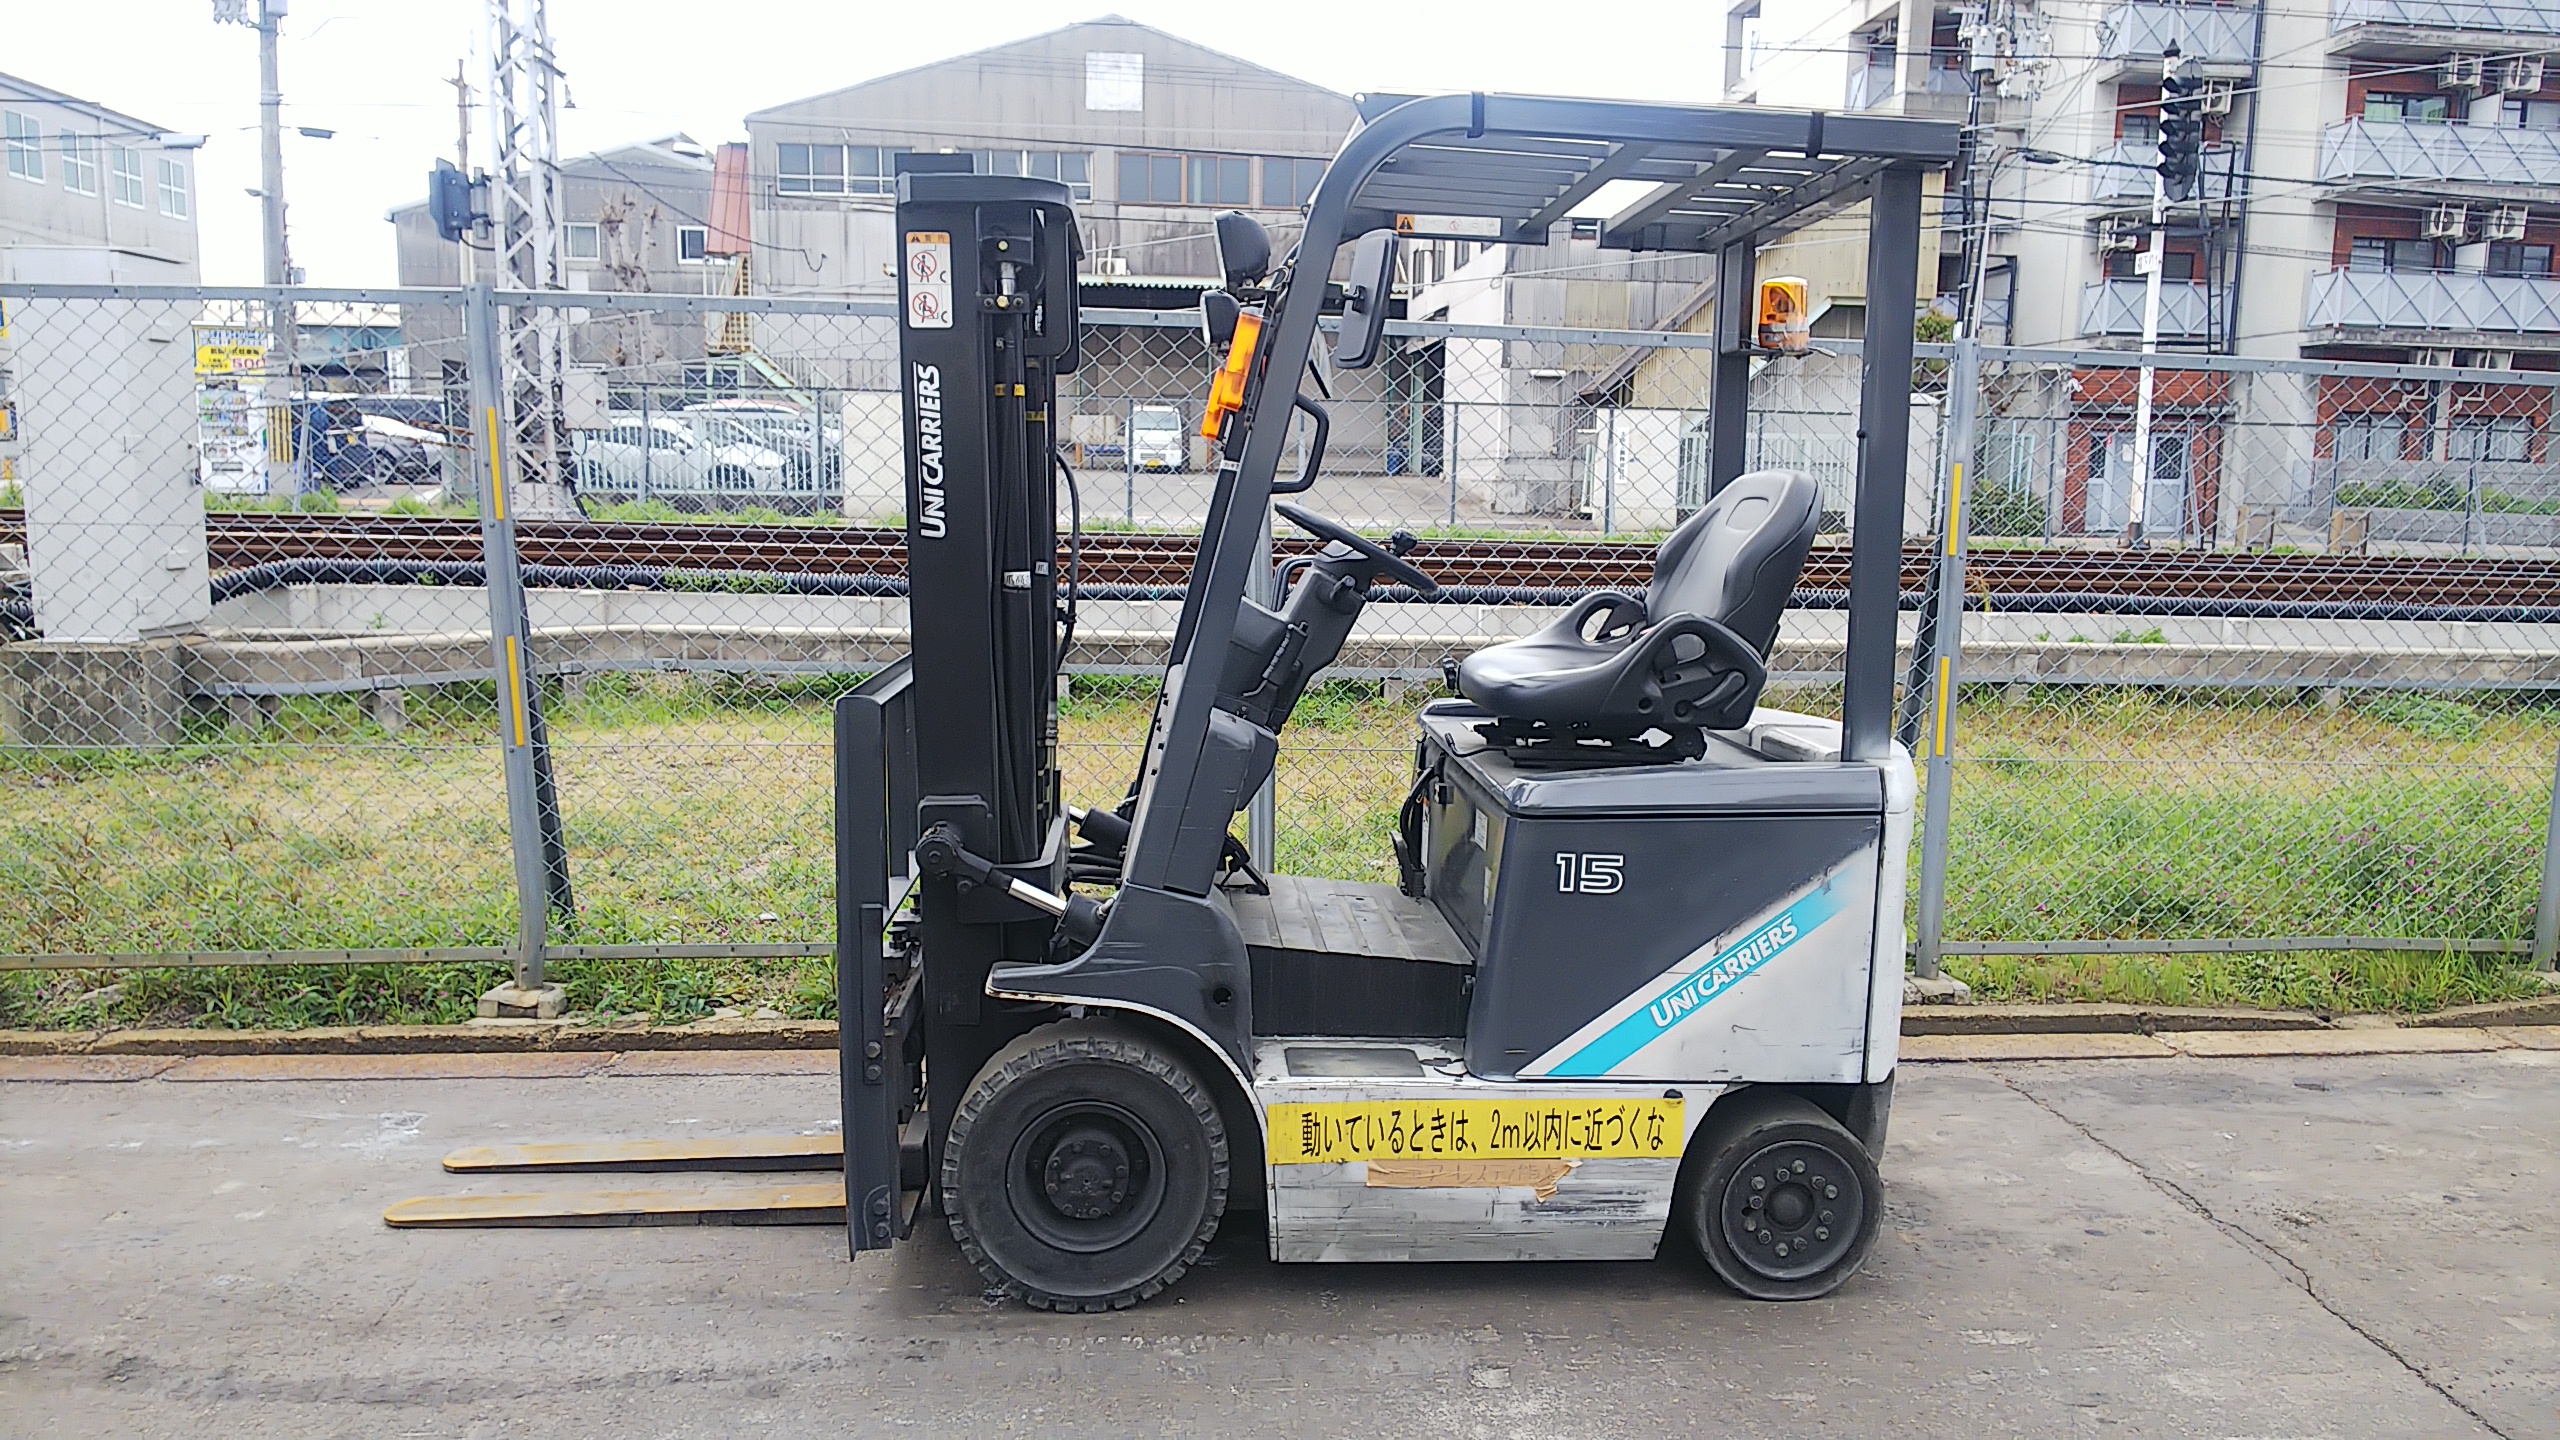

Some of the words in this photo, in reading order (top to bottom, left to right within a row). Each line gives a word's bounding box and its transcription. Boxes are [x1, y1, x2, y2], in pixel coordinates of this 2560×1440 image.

[913, 361, 946, 538] UNICARRIERS
[1556, 853, 1624, 894] 15
[1650, 912, 1798, 1027] UNICARRIERS
[1301, 1104, 1665, 1157] 動いているときは、2m以内に近づくな
